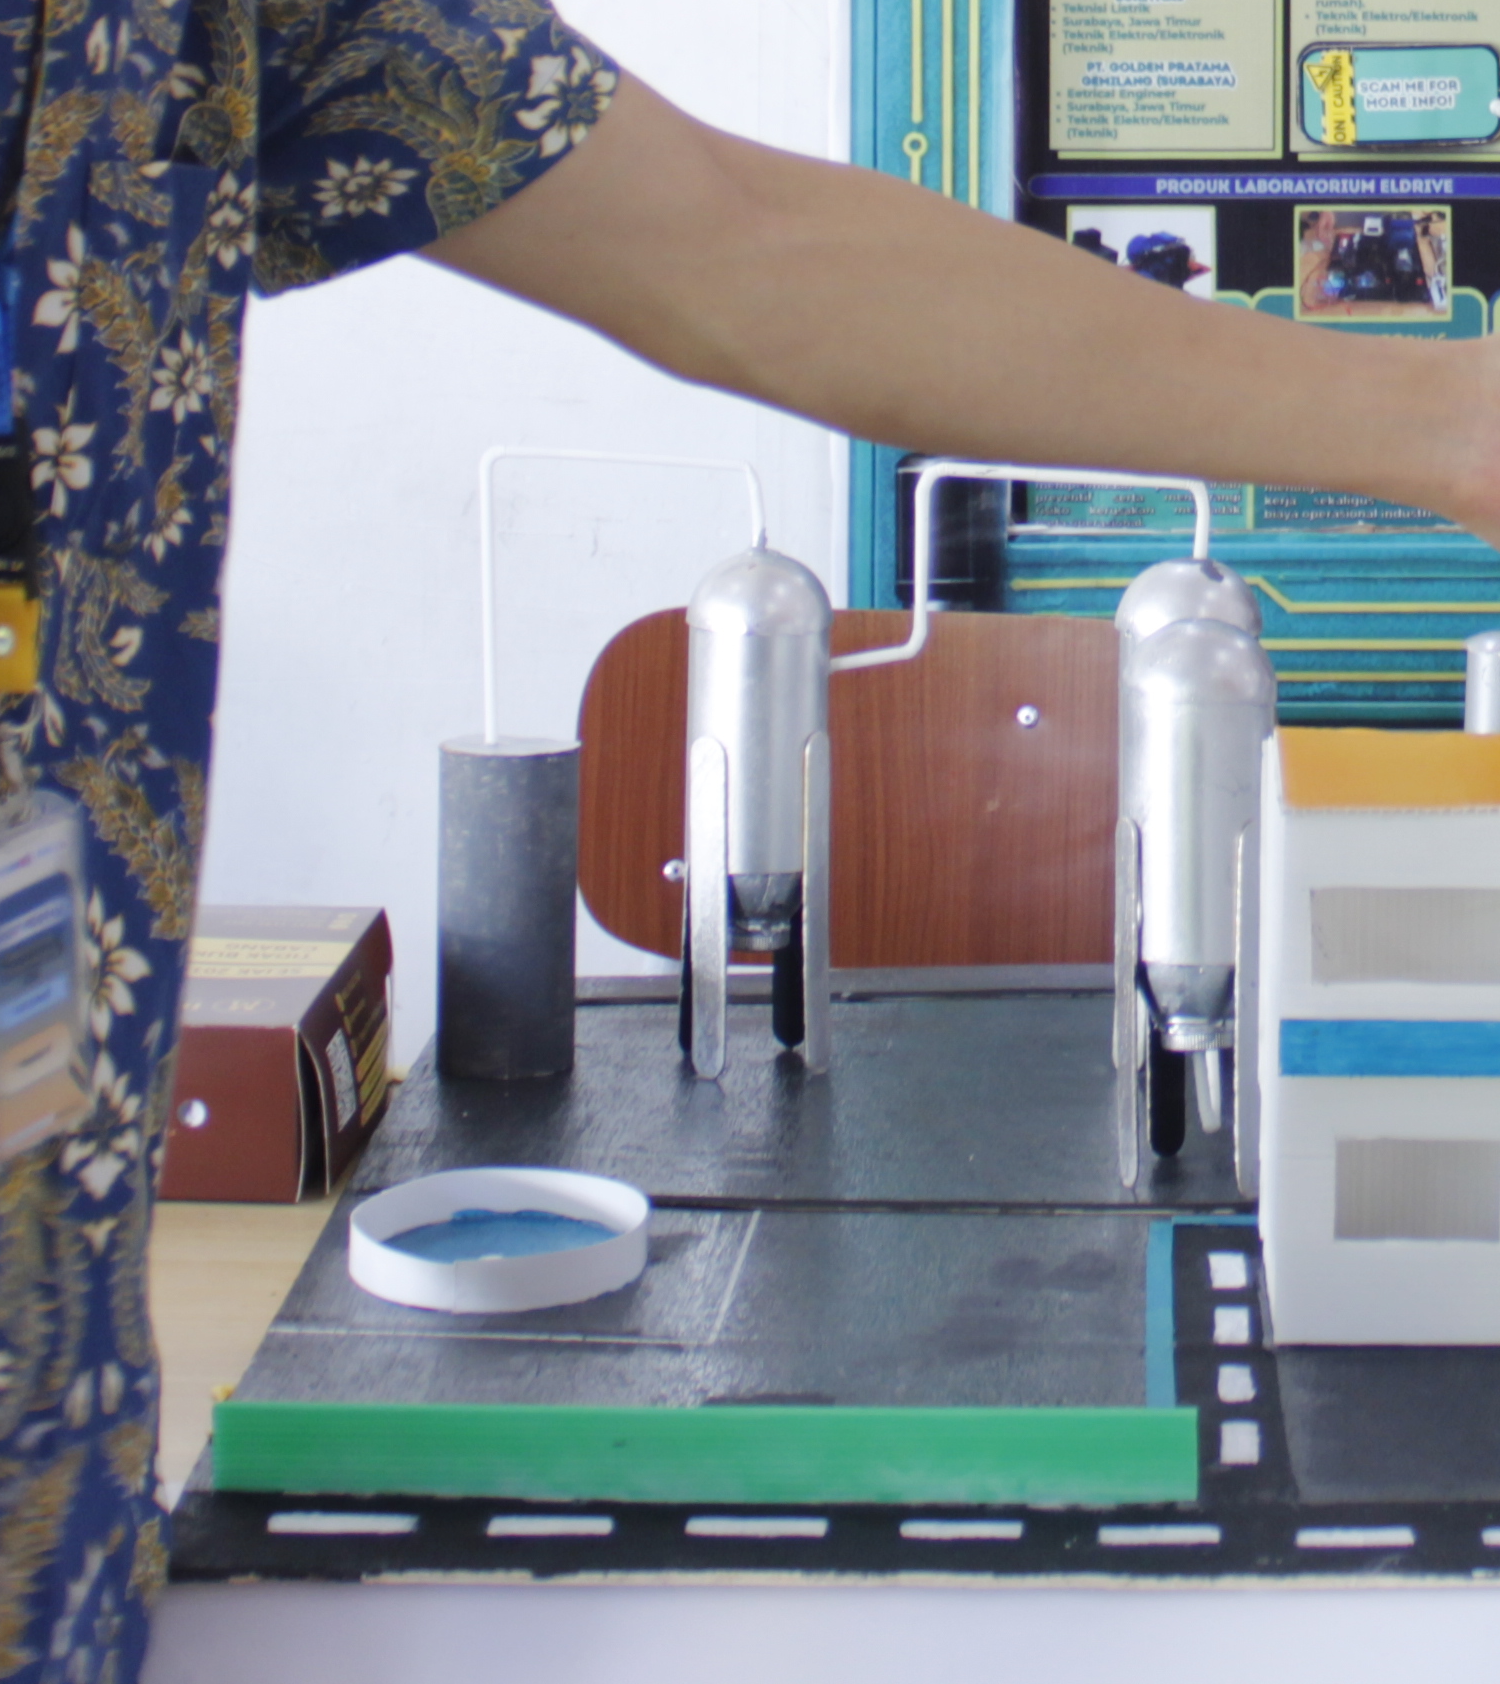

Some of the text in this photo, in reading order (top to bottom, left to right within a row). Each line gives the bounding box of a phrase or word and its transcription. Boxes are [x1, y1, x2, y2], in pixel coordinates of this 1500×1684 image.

[1361, 80, 1458, 93] SCAN ME FOR
[1366, 96, 1453, 108] MORE INFO!
[1333, 119, 1346, 143] ON
[1156, 178, 1453, 194] PRODUK LABORATORIUM ELDRIVE
